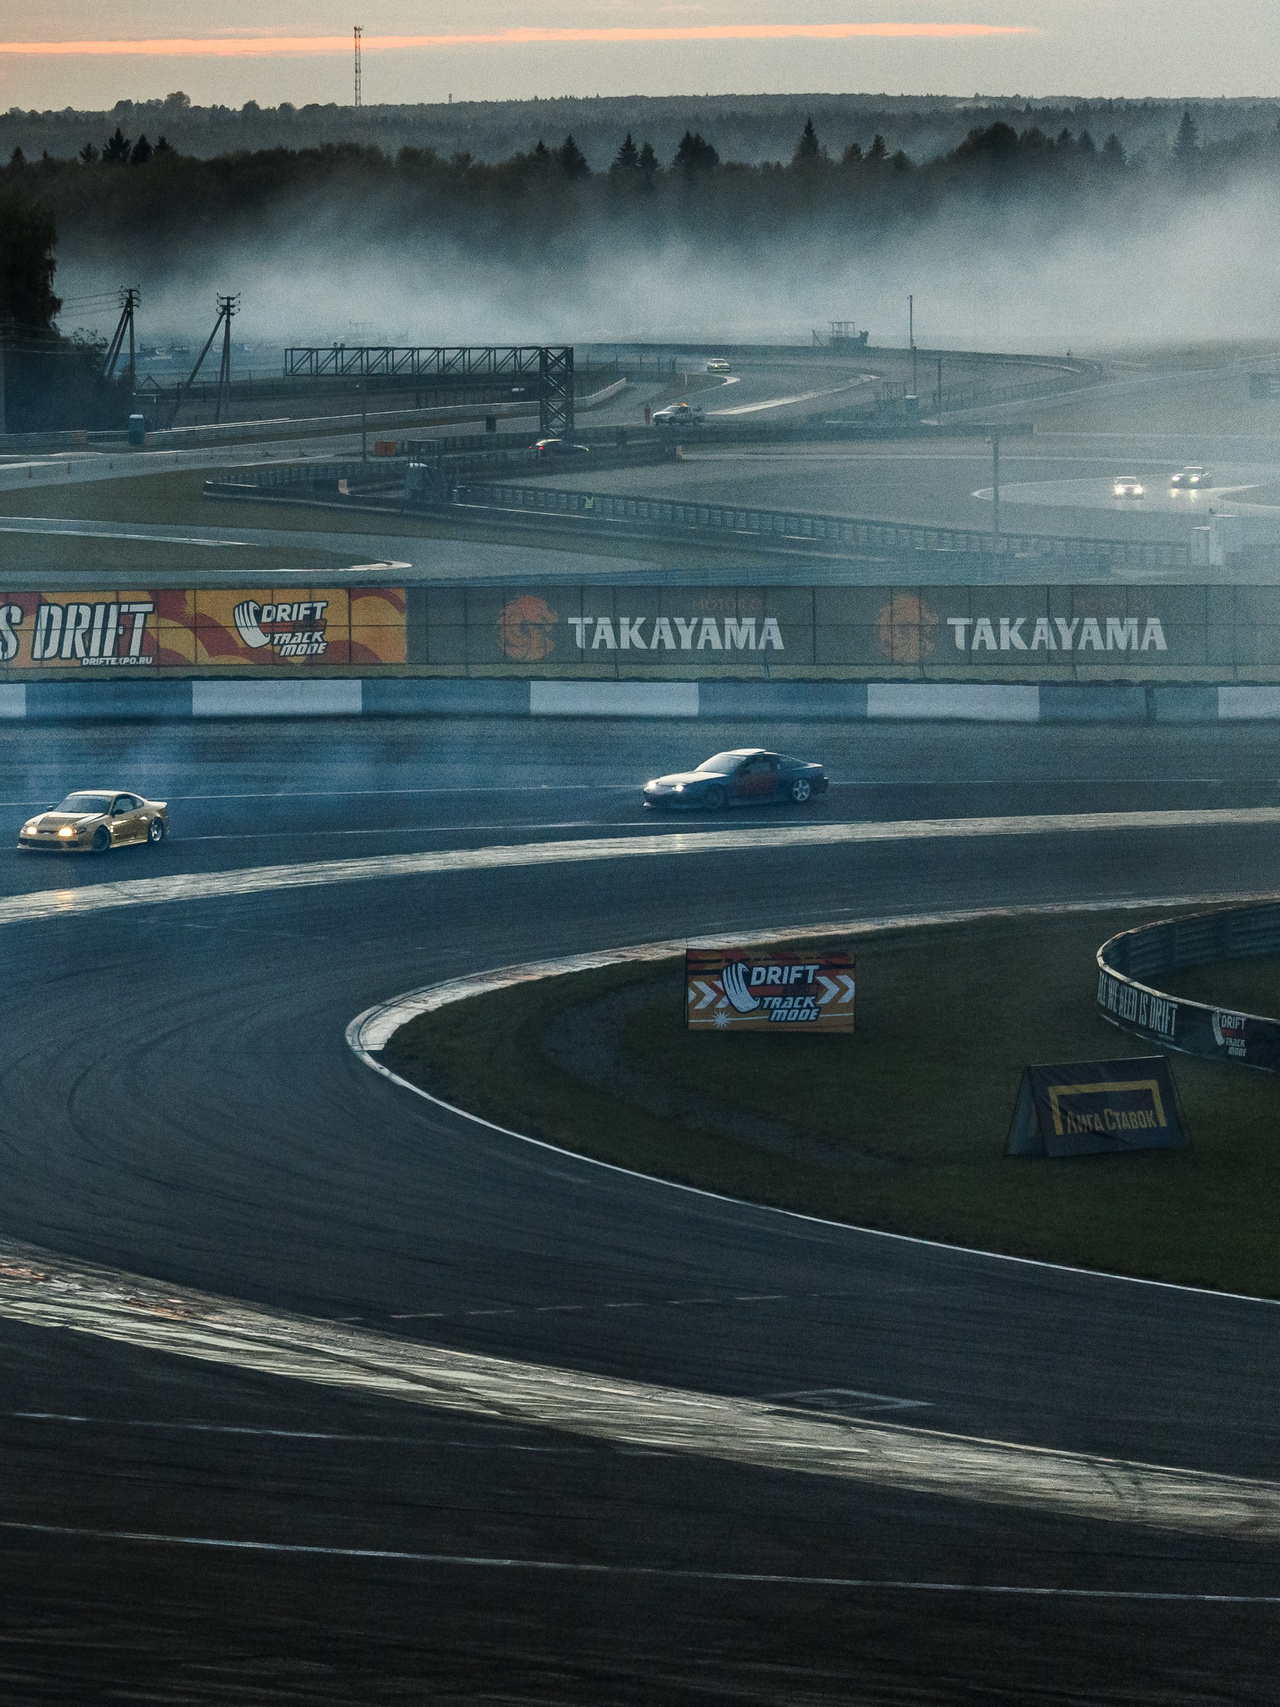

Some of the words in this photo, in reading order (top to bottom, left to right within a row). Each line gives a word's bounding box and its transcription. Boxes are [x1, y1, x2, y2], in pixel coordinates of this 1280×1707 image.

[260, 601, 328, 622] DRIFT
[32, 602, 155, 659] DRIFT
[272, 630, 324, 645] TRACK
[567, 616, 785, 650] TAKAYAMA
[946, 616, 1169, 651] TAKAYAMA
[279, 642, 328, 657] MODE
[82, 656, 154, 666] DRIFTEXPO.RU
[750, 965, 820, 986] DRIFT
[762, 996, 817, 1010] TRACK
[769, 1008, 820, 1021] MODE
[1138, 991, 1149, 1026] IS
[1149, 996, 1179, 1036] DRIFT
[1221, 1014, 1247, 1030] DRIFT
